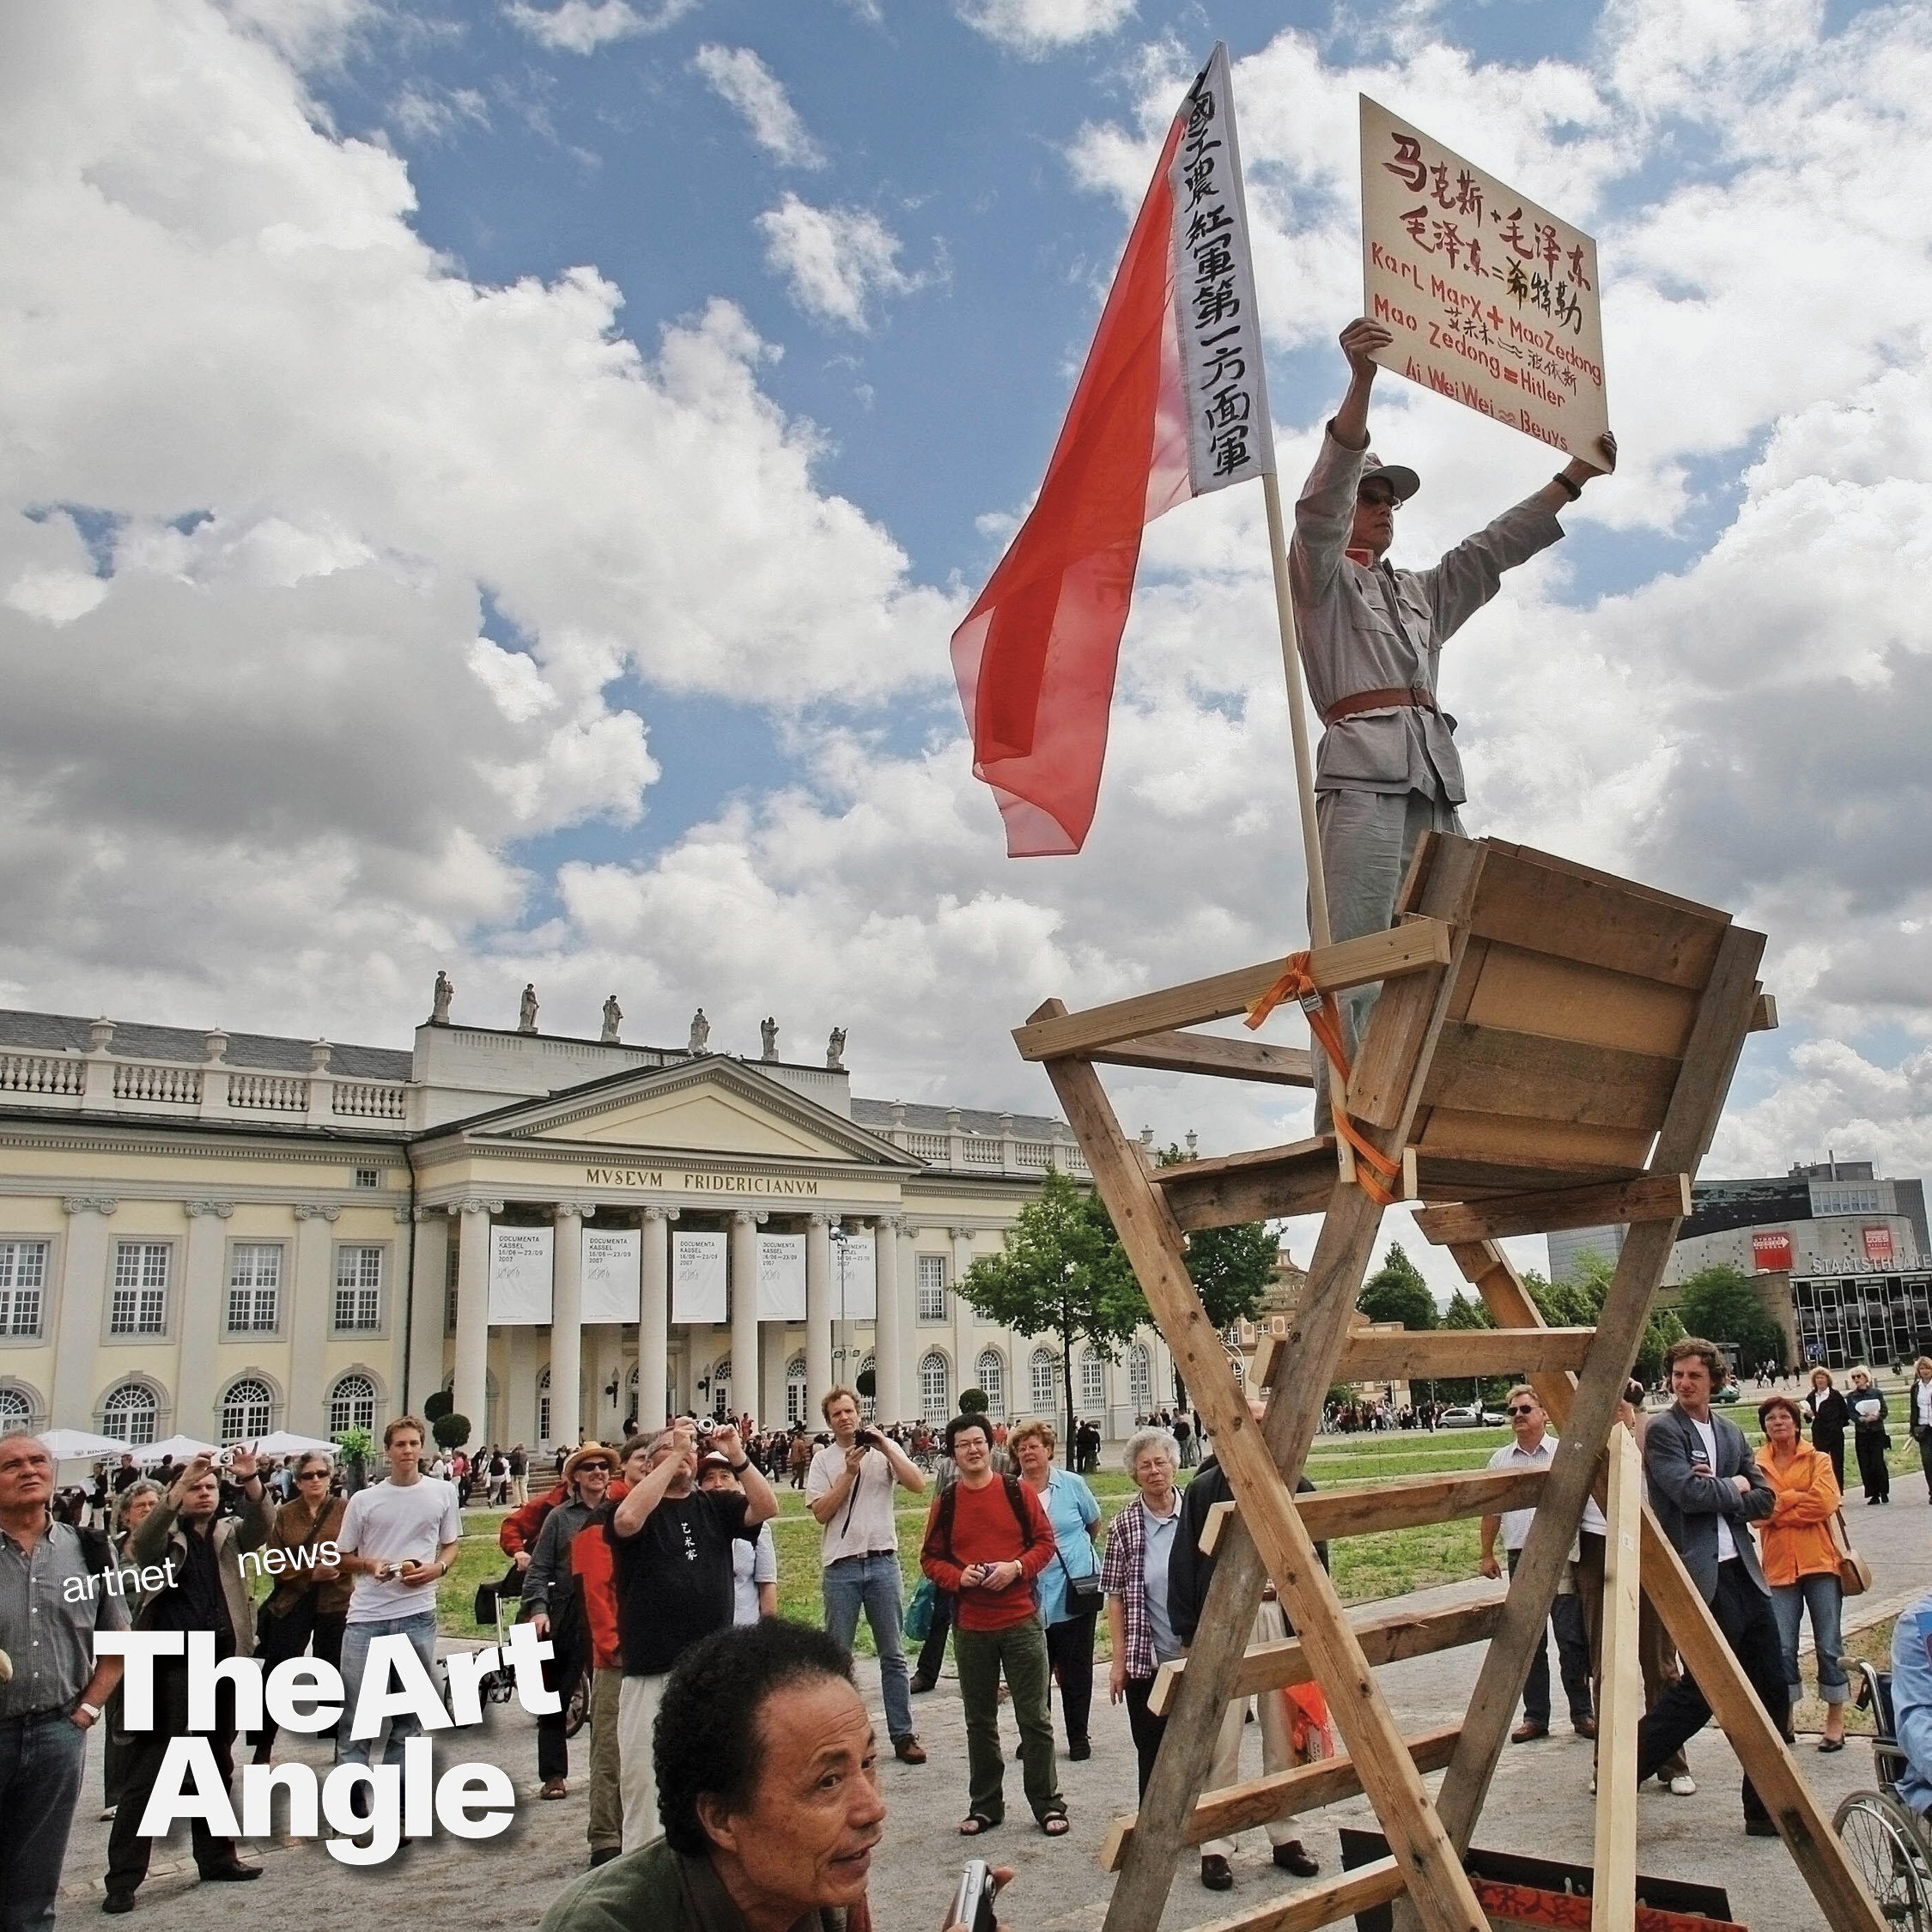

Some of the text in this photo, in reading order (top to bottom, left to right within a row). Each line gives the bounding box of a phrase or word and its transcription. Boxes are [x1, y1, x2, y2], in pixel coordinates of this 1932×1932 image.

[1375, 293, 1418, 331] Mao
[1406, 355, 1421, 384] Ai
[586, 1169, 817, 1195] MVSEVM FRIDERICIANVM
